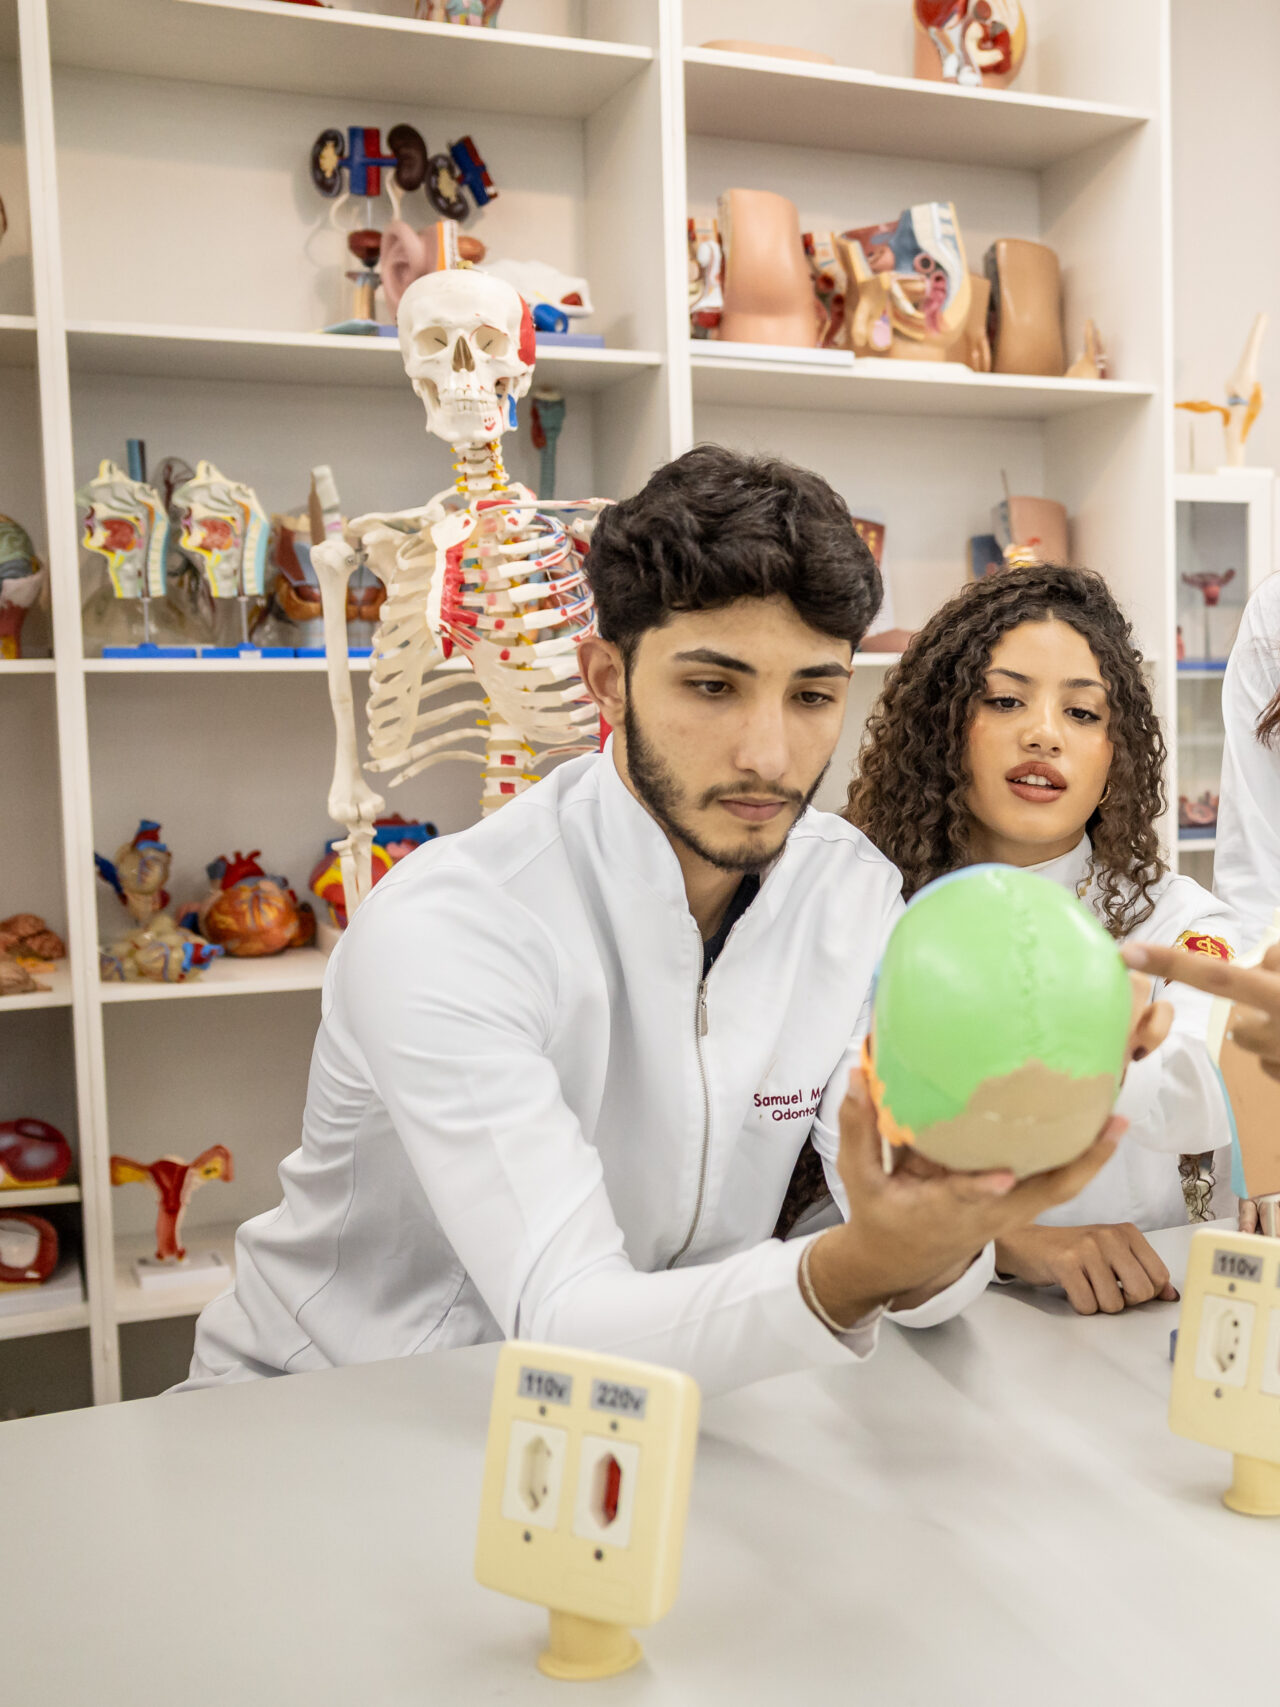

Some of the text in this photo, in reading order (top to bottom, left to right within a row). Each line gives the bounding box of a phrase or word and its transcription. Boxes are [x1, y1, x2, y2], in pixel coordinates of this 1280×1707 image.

[753, 1089, 803, 1107] Samuel
[1218, 1254, 1259, 1277] 110v
[525, 1372, 568, 1400] 110v
[597, 1384, 643, 1411] 220v
